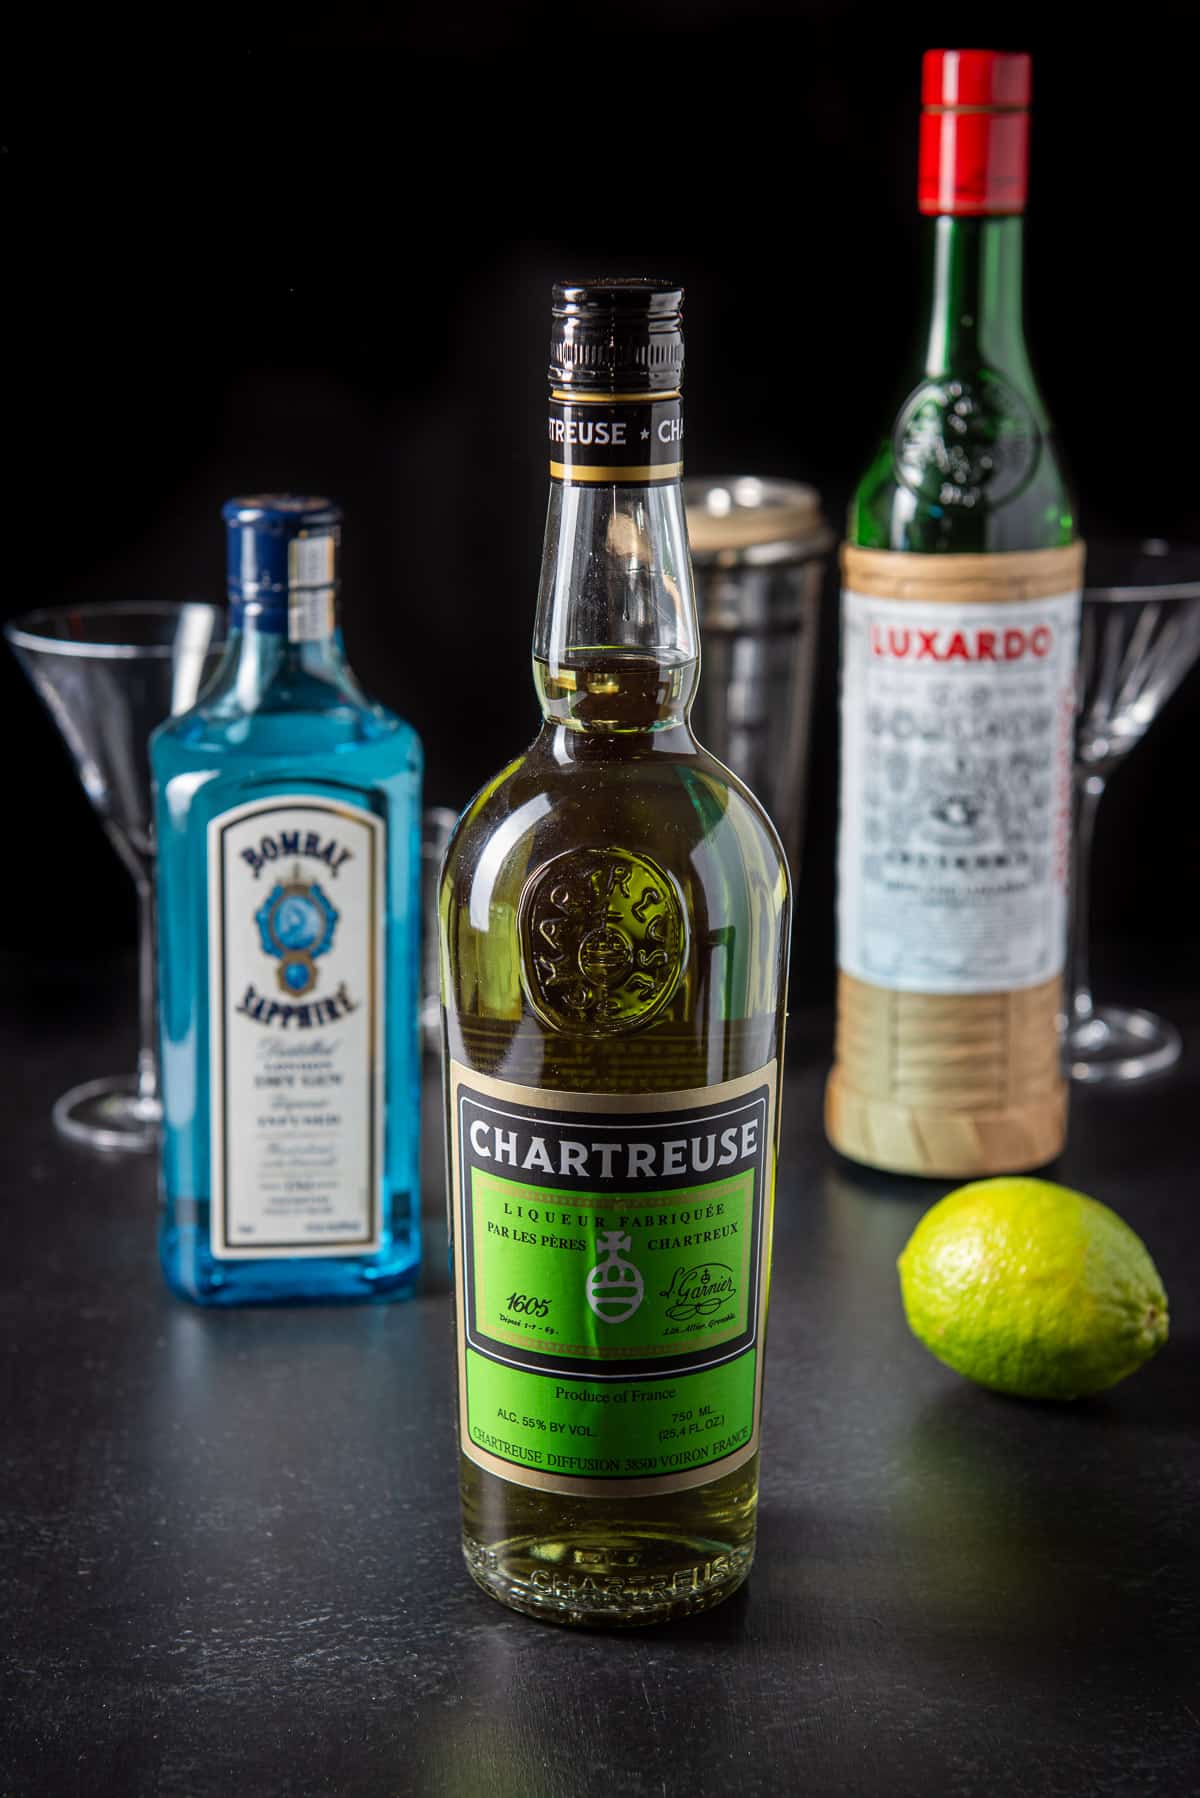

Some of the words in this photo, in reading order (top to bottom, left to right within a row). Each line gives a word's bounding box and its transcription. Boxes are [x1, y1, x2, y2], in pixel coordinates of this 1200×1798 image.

[549, 417, 627, 445] TREUSE
[871, 624, 1053, 661] LUXARDO
[241, 831, 353, 878] BOMBAY
[470, 1119, 759, 1178] CHARTREUSE
[504, 1202, 606, 1228] LIQUEUR
[620, 1203, 725, 1228] FABRIQUÉE
[488, 1220, 509, 1238] PAR
[513, 1230, 537, 1245] LES
[541, 1233, 587, 1251] PÈRES
[648, 1222, 738, 1251] CHARTREUX
[506, 1292, 552, 1318] 1605
[613, 1389, 627, 1403] of
[631, 1388, 677, 1403] France
[497, 1407, 520, 1424] ALC.
[522, 1416, 547, 1431] 55%
[549, 1421, 566, 1433] BY
[672, 1410, 693, 1424] 750
[473, 1426, 543, 1463] CHARTREUSE
[547, 1453, 620, 1472] DIFFUSION
[659, 1446, 709, 1467] VOIRON
[712, 1425, 749, 1455] FRANCE
